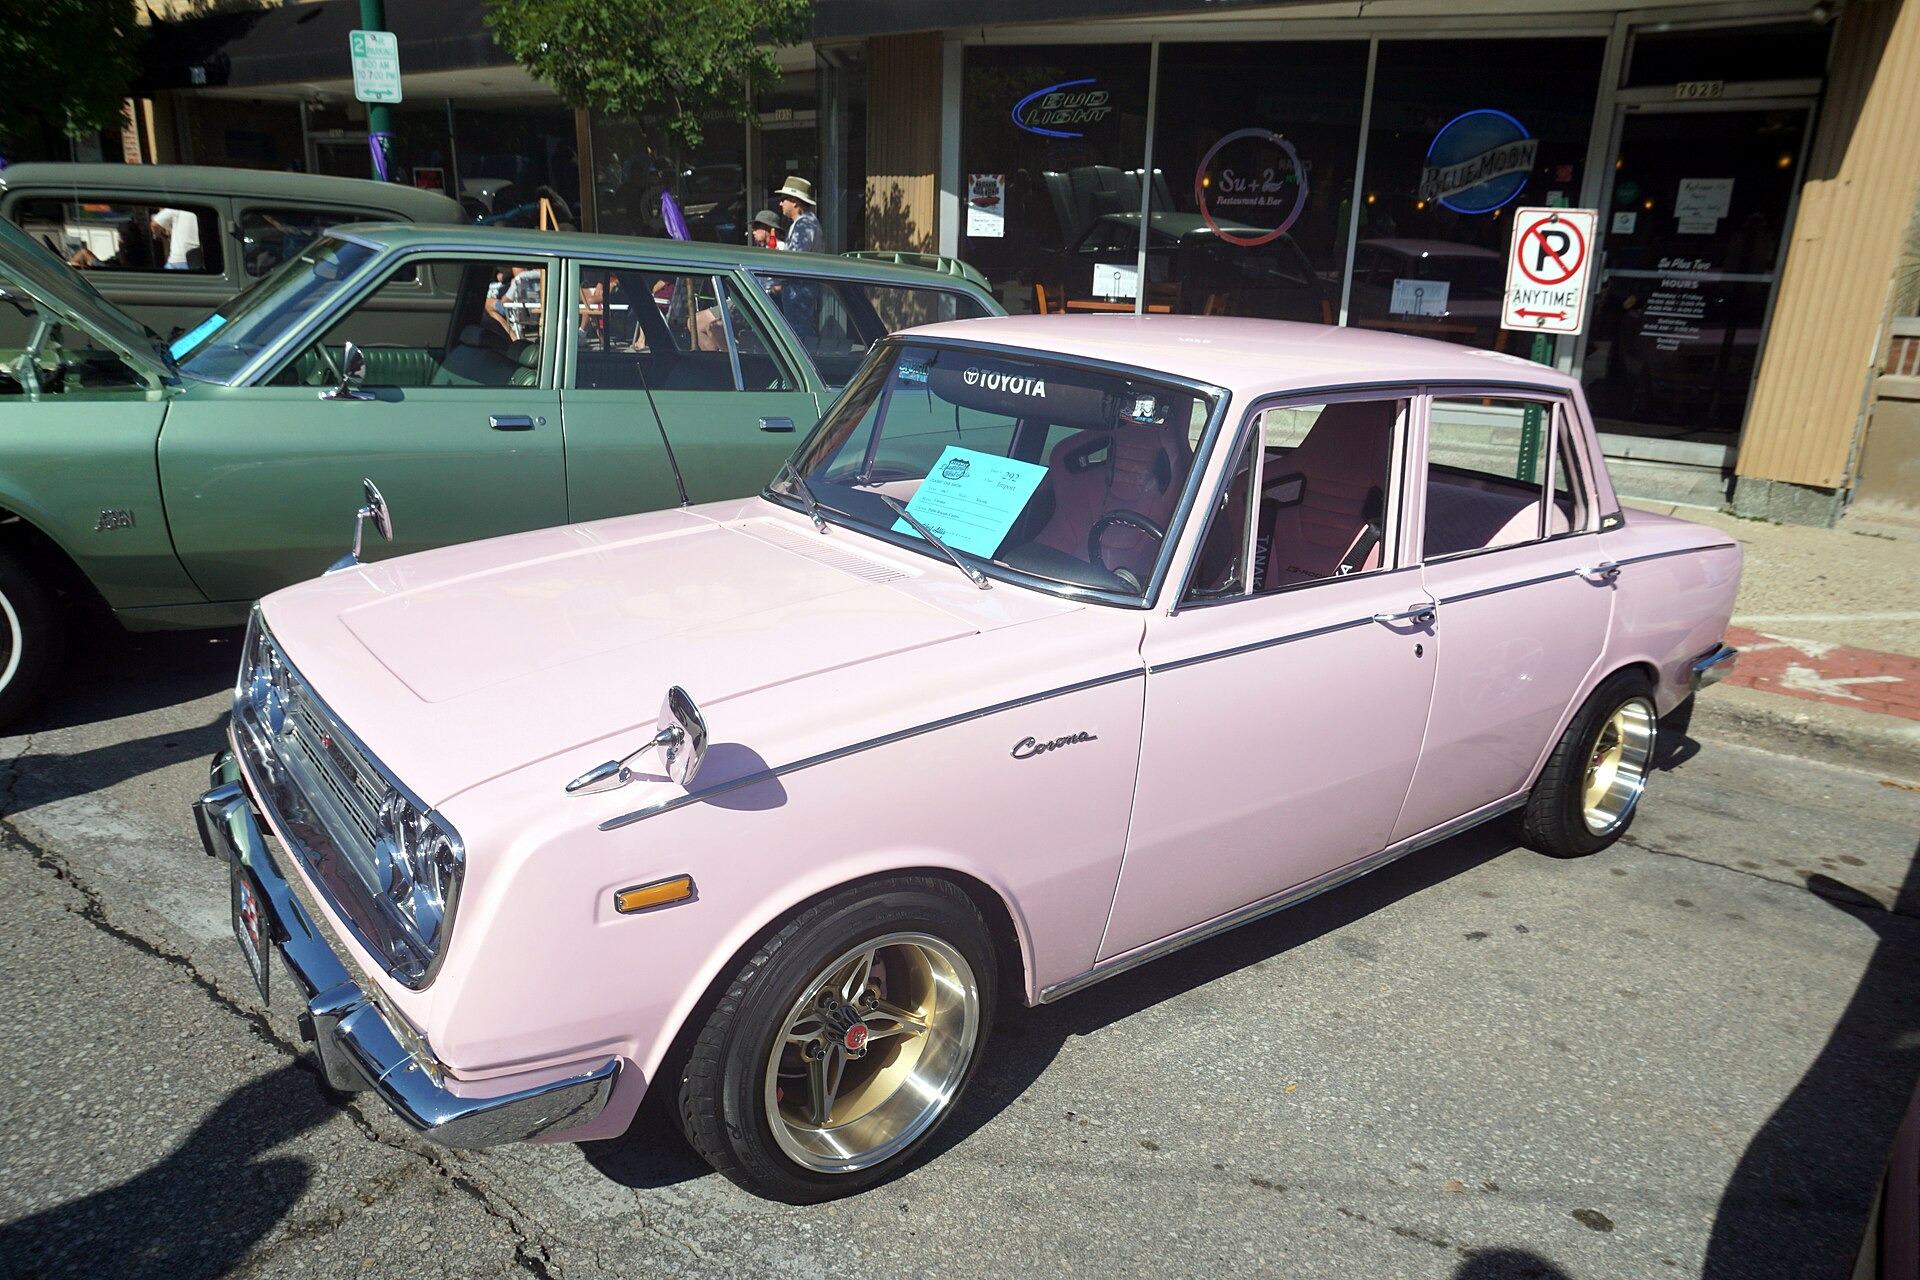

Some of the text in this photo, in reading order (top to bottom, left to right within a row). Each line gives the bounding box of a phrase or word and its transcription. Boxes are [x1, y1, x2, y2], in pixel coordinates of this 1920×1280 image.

[354, 36, 365, 53] 2
[367, 46, 394, 56] PARKING
[1678, 83, 1720, 98] 7028
[1041, 91, 1109, 110] BUD
[1025, 106, 1112, 125] LIGHT
[1420, 144, 1536, 198] BLUE MOON
[1219, 169, 1247, 192] Su
[1216, 196, 1282, 206] Restaurant & Bar
[1536, 230, 1570, 272] P
[1657, 257, 1711, 270] Su Plus Two
[1661, 279, 1699, 289] HOURS
[1513, 288, 1576, 308] ANYTIME
[979, 369, 1046, 398] TOYOTA
[1001, 471, 1020, 483] 292
[996, 481, 1016, 492] Import
[1010, 731, 1098, 760] Corona
